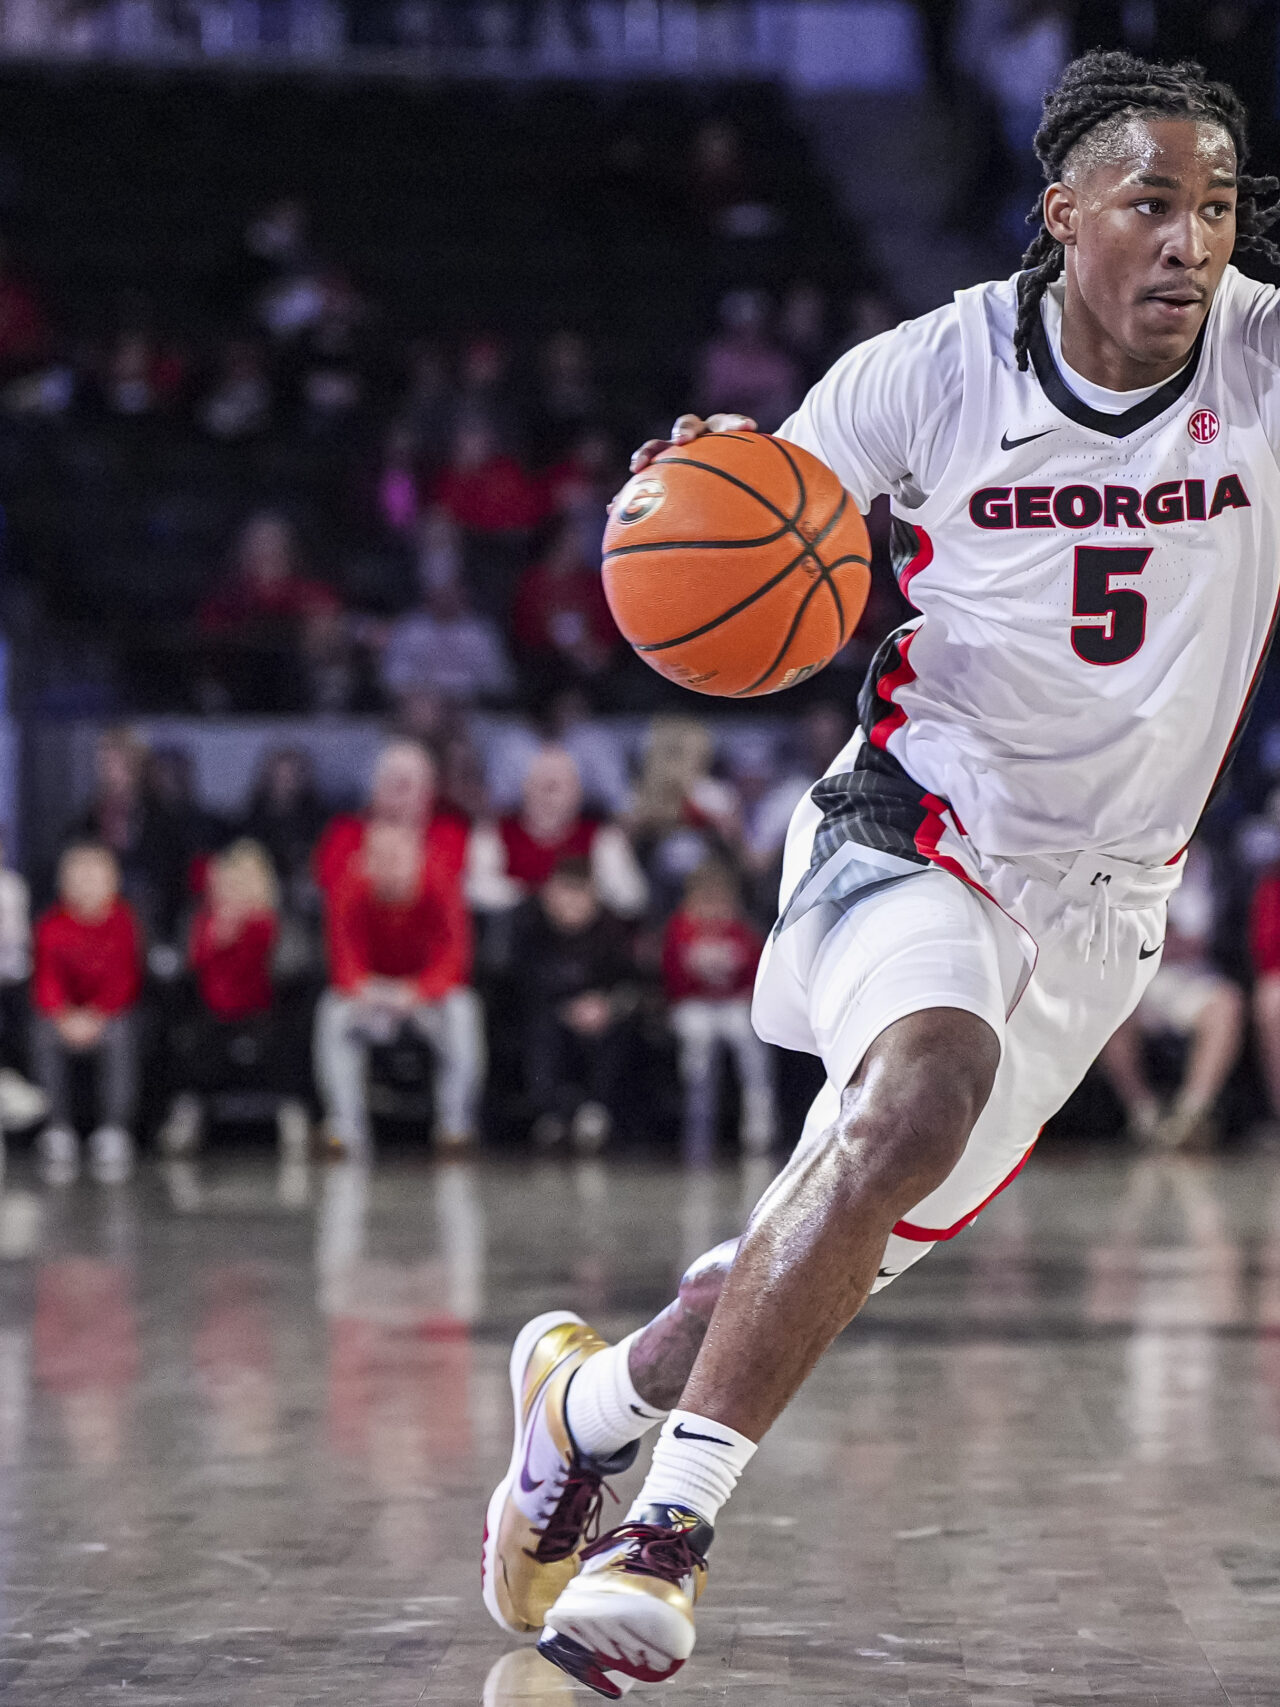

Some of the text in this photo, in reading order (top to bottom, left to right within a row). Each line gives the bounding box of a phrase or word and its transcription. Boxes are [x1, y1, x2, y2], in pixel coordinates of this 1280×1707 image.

[1190, 412, 1217, 441] SEC
[968, 473, 1252, 530] GEORGIA
[1070, 545, 1154, 666] 5
